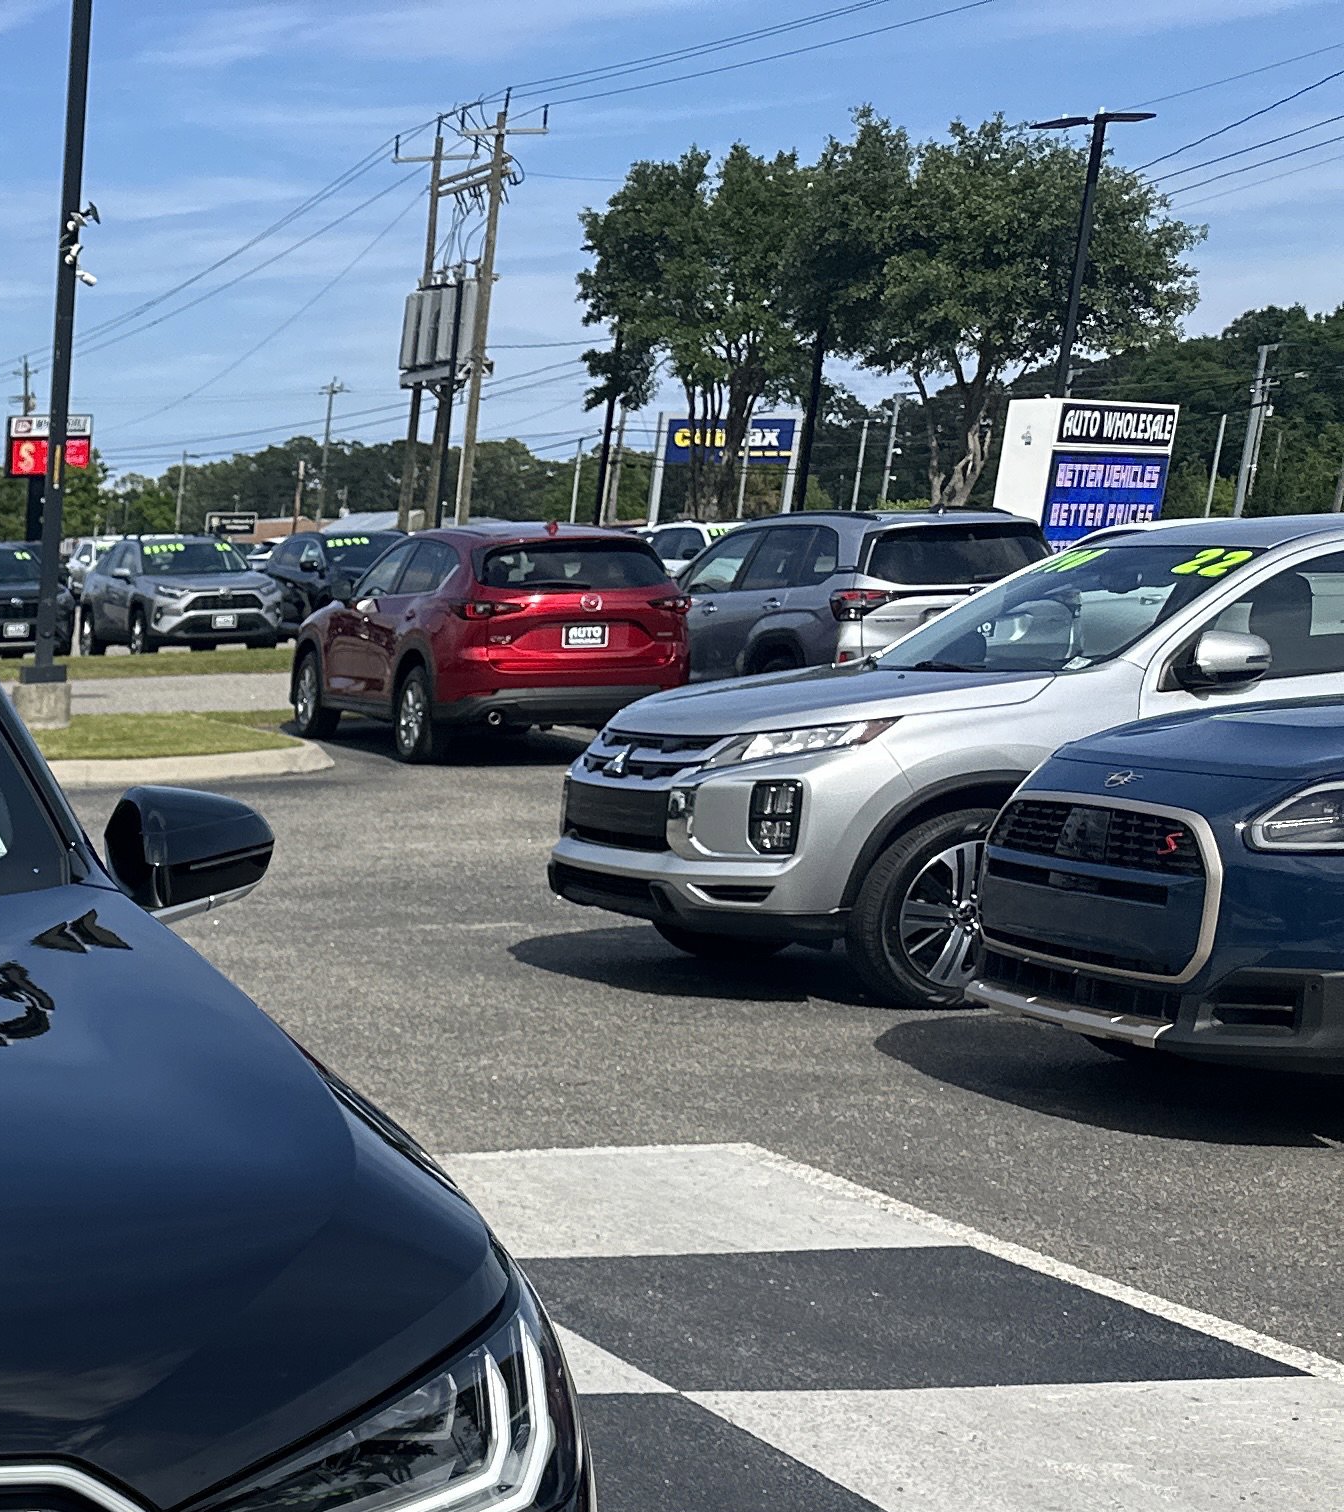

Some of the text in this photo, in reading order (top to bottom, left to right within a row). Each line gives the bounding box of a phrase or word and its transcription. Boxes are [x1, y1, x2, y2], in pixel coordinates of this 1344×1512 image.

[1063, 410, 1174, 442] AUTO WHOLESALE
[1055, 463, 1160, 489] BETTER VEHICLES
[1049, 503, 1154, 527] BETTER PRICES
[1171, 548, 1253, 577] 22
[569, 626, 602, 639] AUTO
